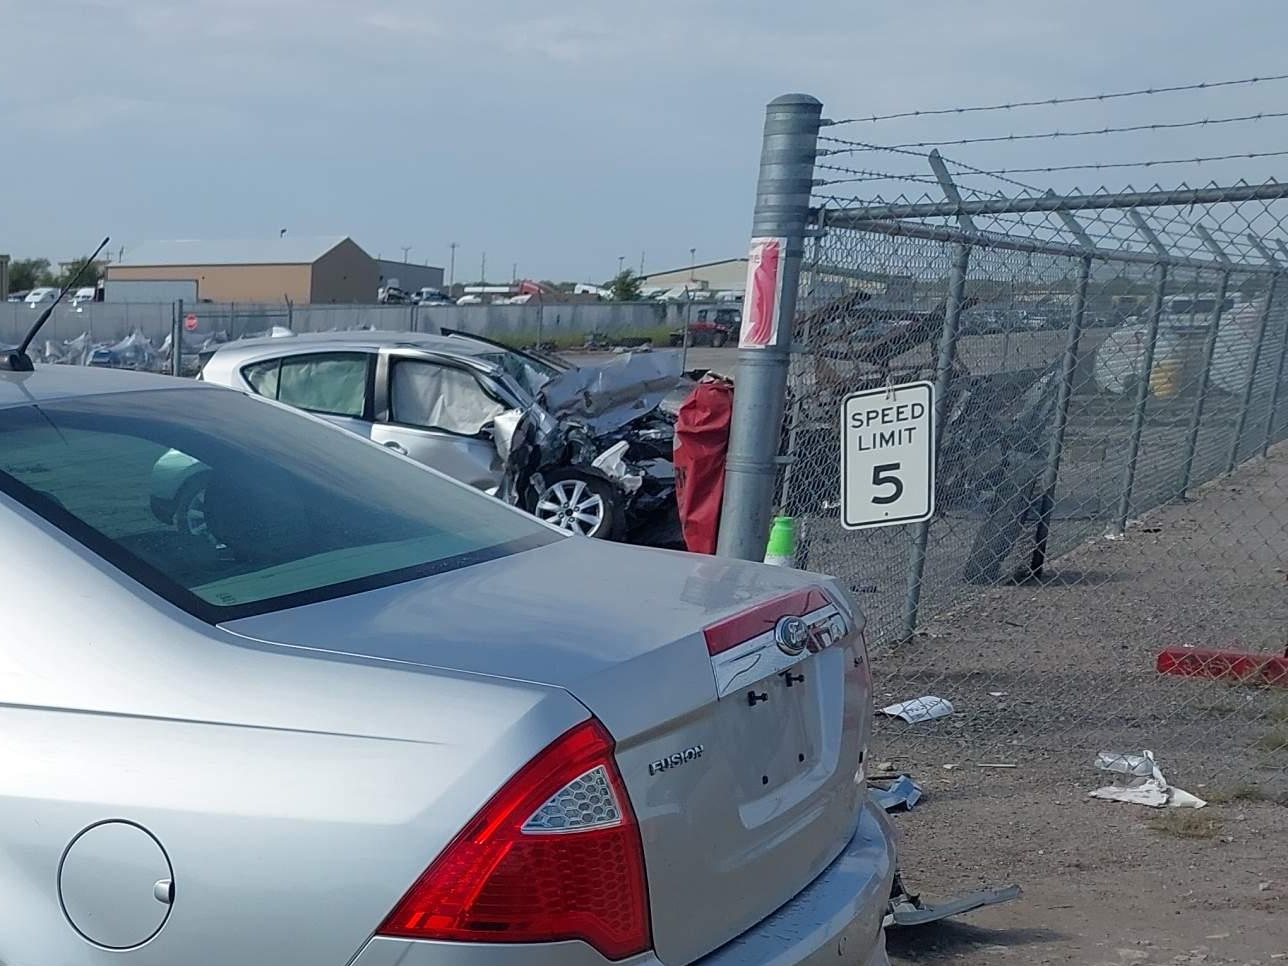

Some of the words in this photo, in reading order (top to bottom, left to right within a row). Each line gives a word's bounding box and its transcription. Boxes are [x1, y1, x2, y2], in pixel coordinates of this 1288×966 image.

[851, 402, 925, 429] SPEED
[858, 426, 917, 451] LIMIT
[871, 462, 904, 505] 5
[649, 744, 705, 775] FUSION
